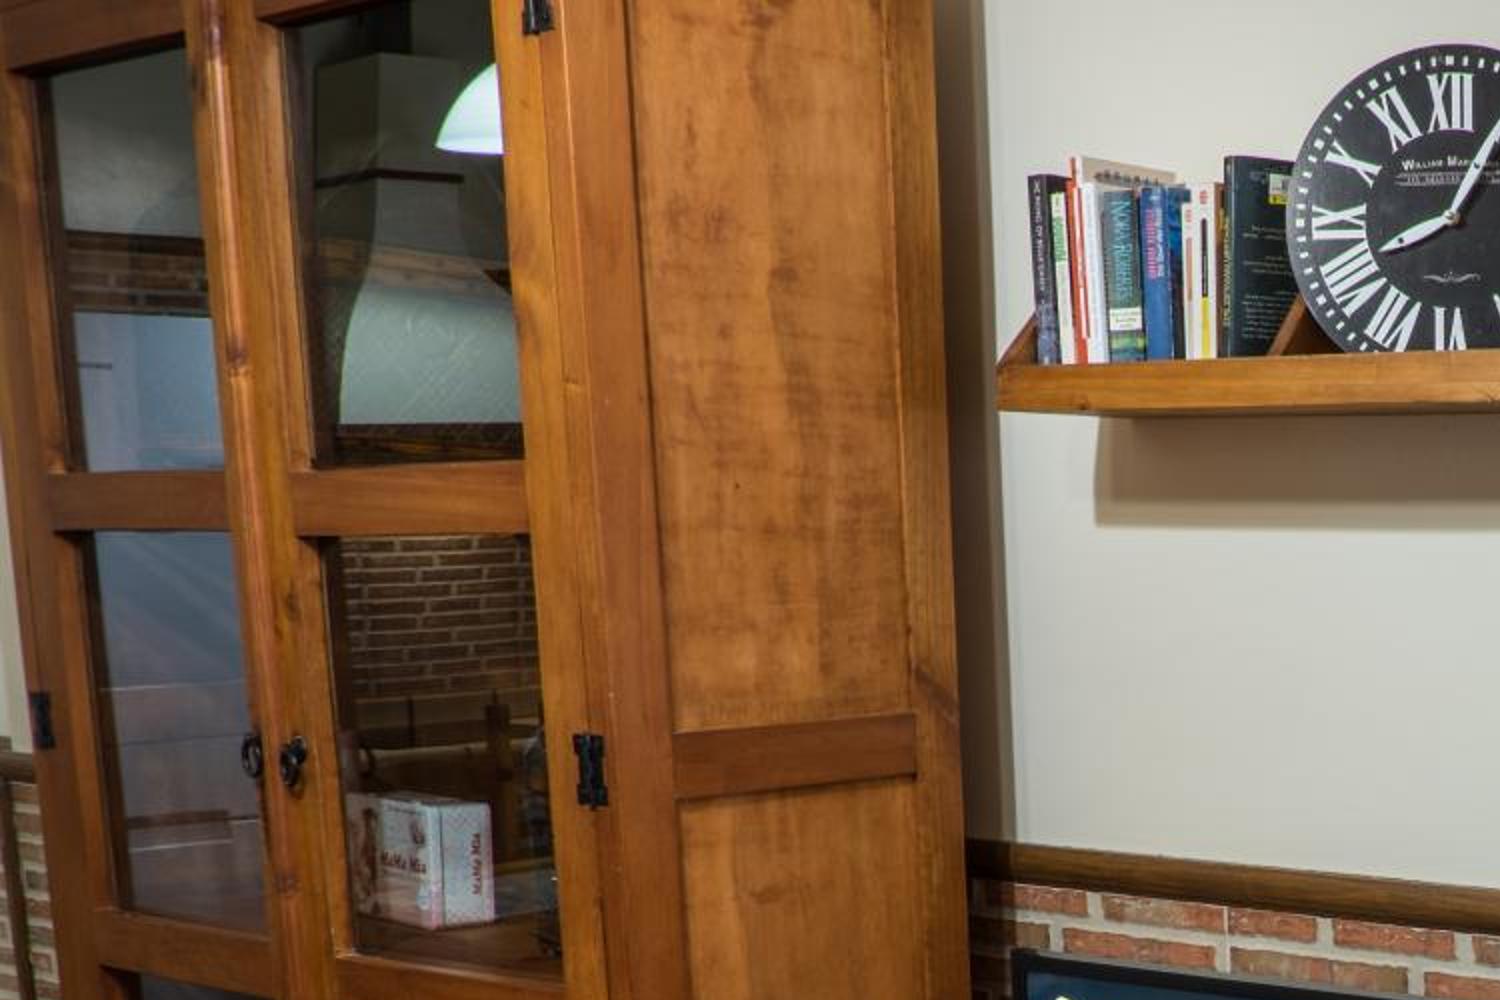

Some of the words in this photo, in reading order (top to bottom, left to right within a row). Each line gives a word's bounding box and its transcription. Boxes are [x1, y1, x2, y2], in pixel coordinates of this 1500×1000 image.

[1366, 86, 1423, 153] XI
[1426, 72, 1474, 133] XII
[1324, 139, 1382, 188] X
[1311, 203, 1368, 241] IX
